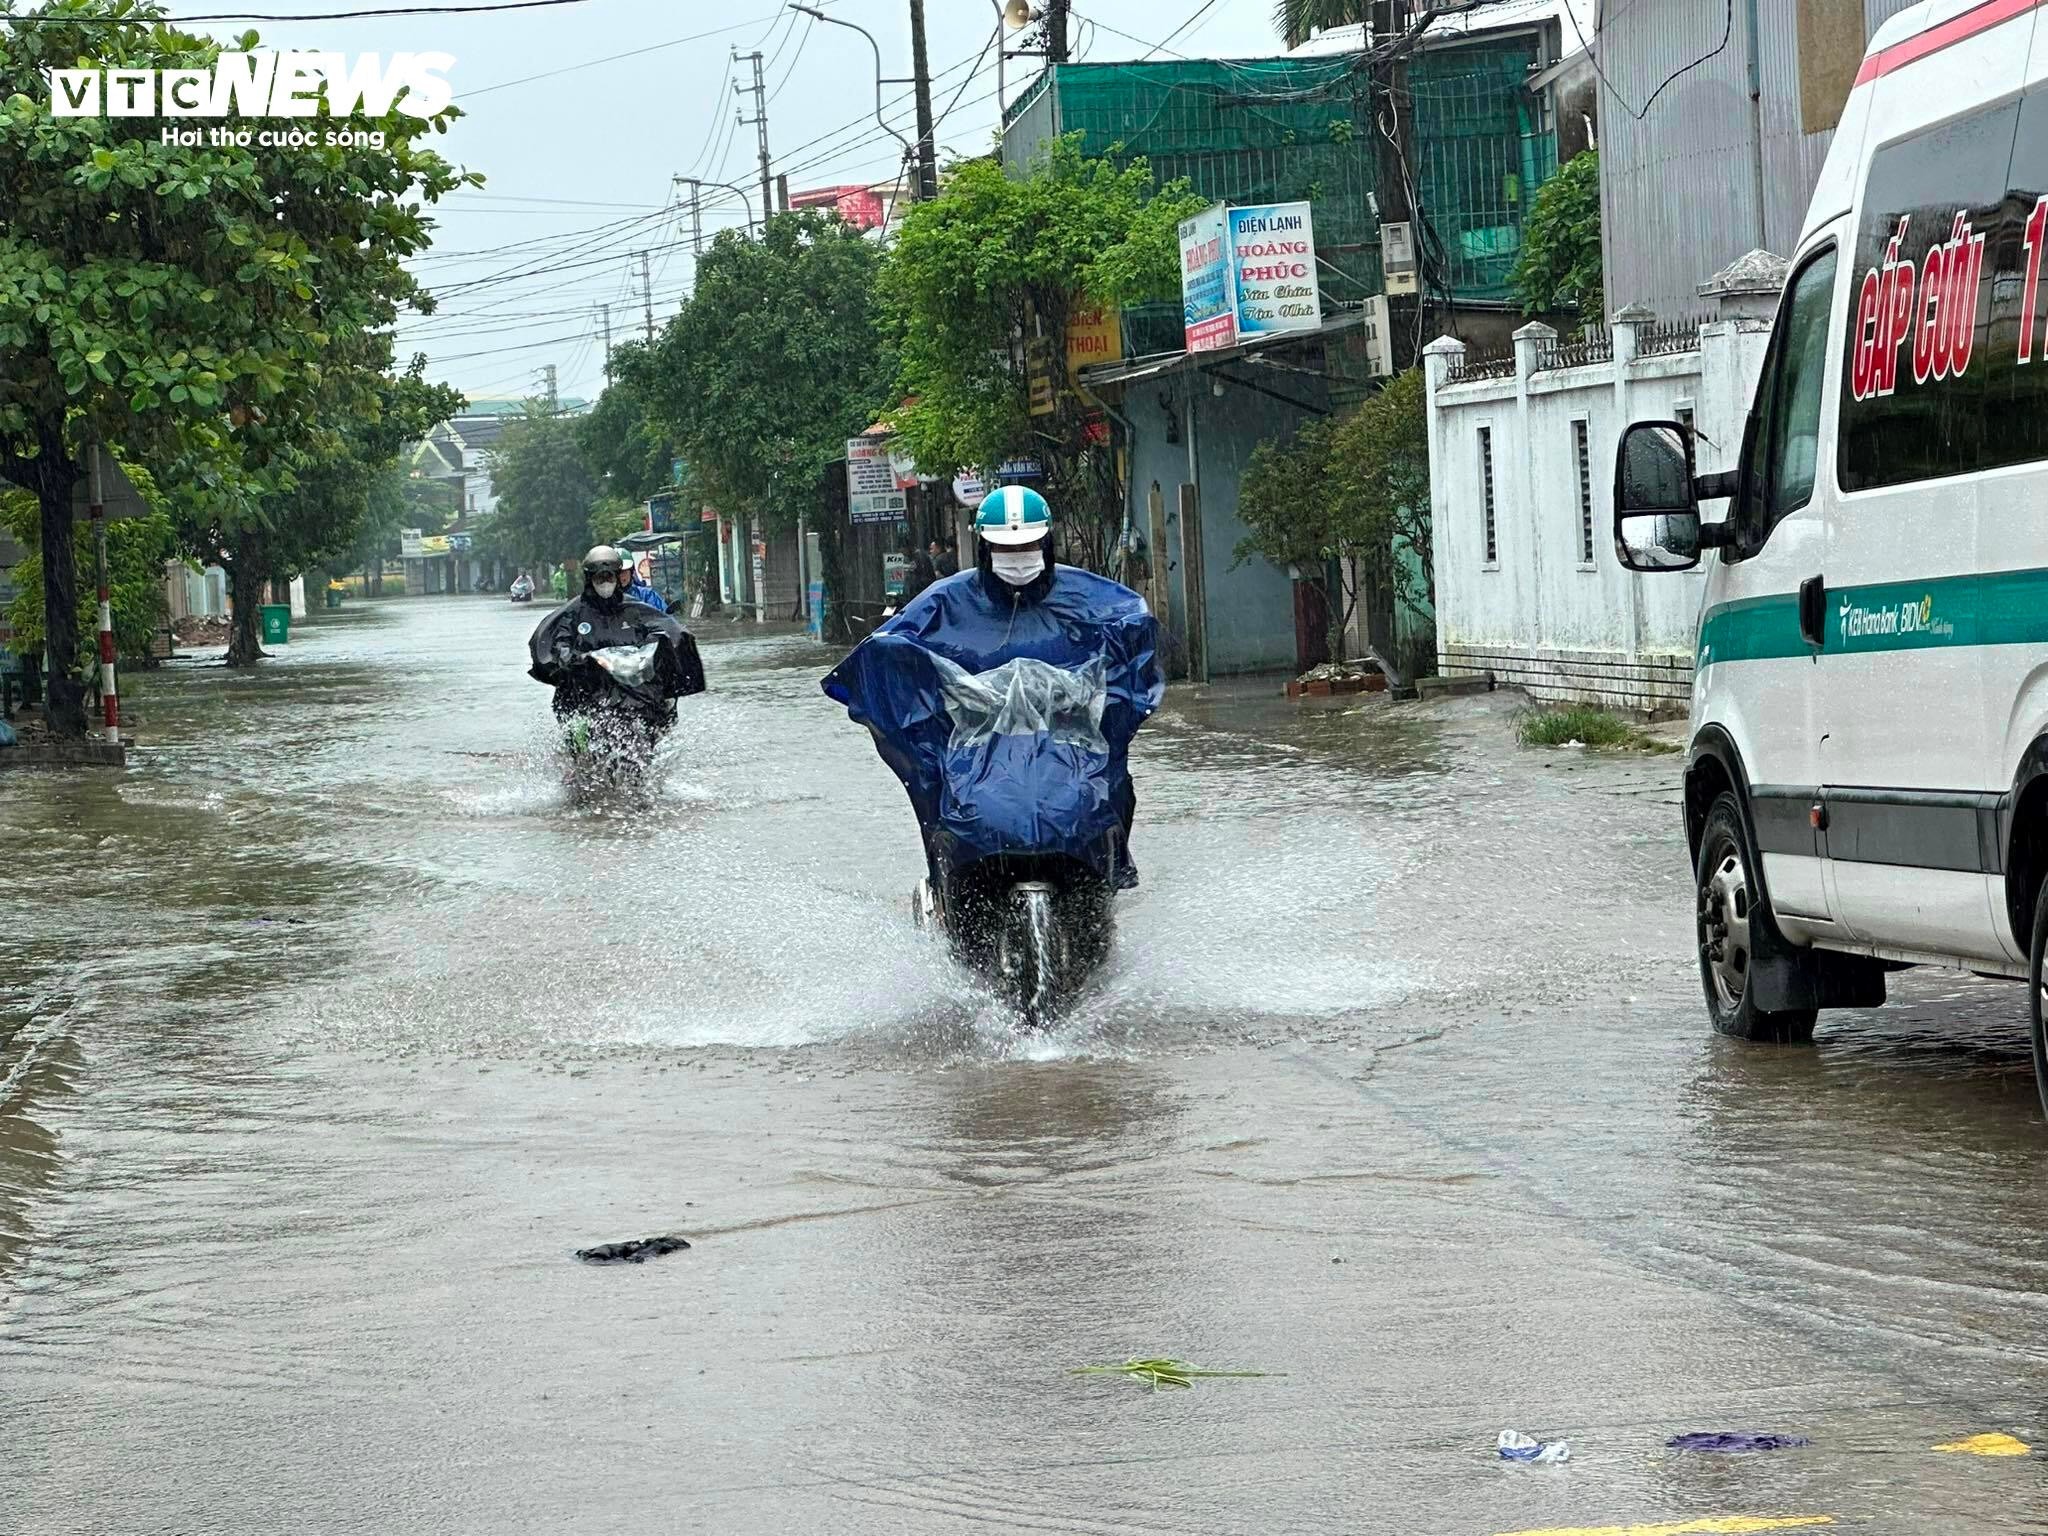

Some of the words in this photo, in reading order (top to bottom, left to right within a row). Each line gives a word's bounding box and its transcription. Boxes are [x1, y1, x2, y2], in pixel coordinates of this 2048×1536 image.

[1238, 217, 1266, 235] ĐIỆN
[1270, 216, 1302, 234] LẠNH
[1236, 240, 1309, 258] HOÀNG
[1241, 262, 1309, 282] PHÚC
[1852, 213, 1915, 402] CẤP
[1913, 209, 1986, 385] CỨU
[1862, 607, 1880, 635] Hana
